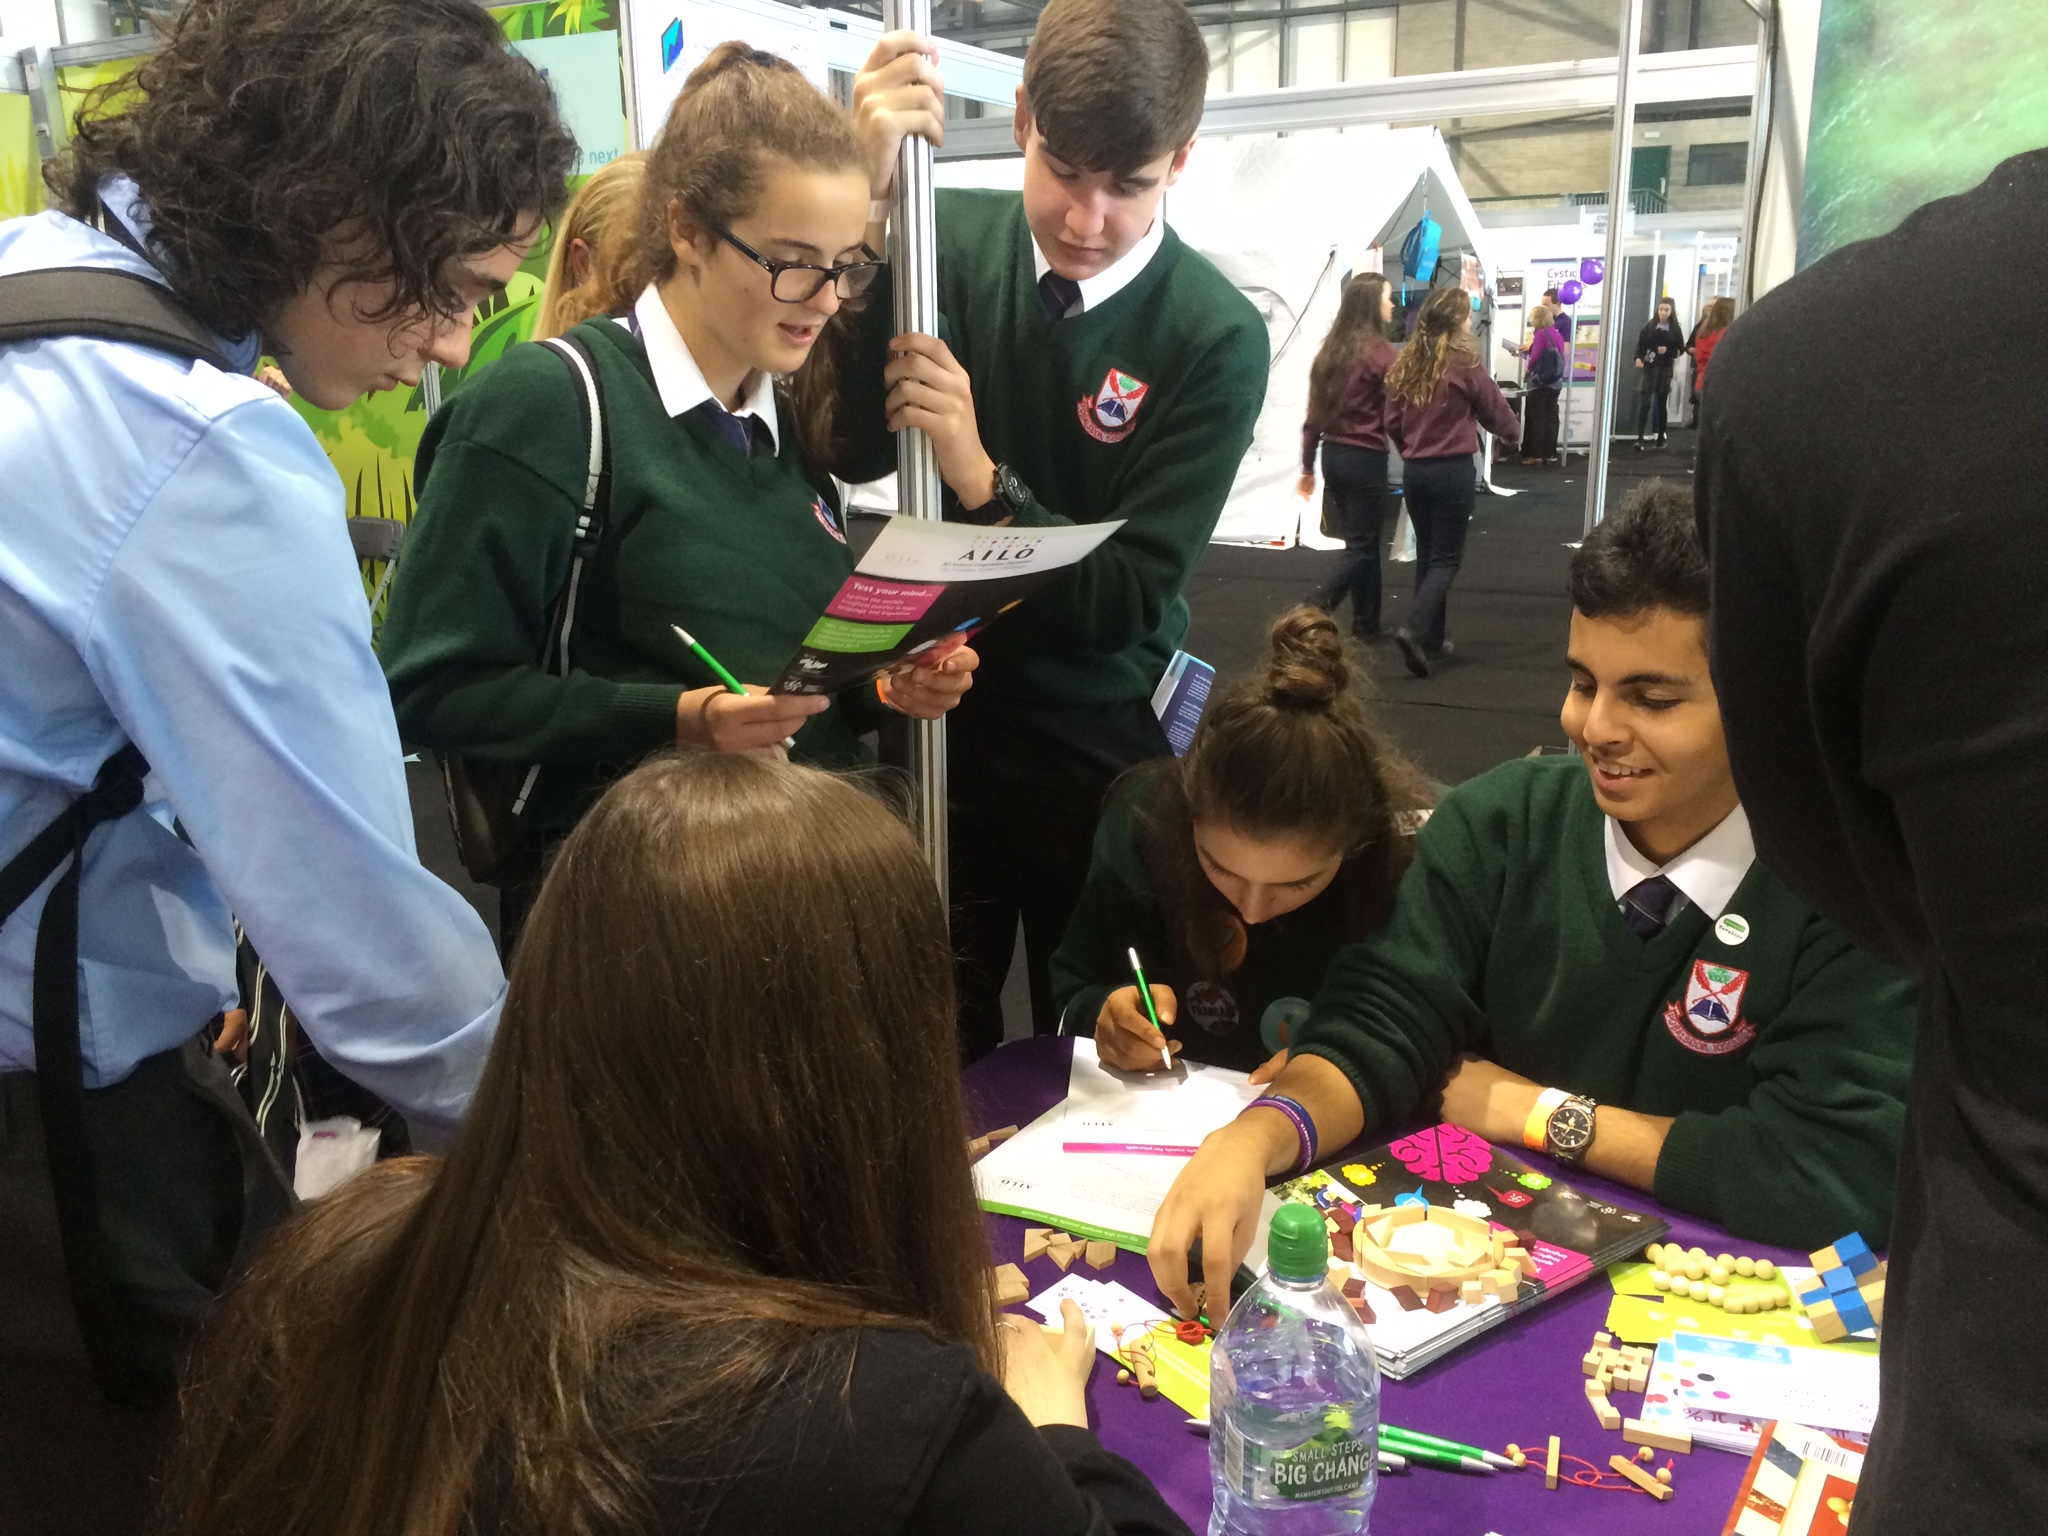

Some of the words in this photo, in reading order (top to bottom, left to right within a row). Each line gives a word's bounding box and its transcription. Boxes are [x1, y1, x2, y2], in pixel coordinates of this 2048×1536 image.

[589, 147, 618, 164] next
[958, 548, 1035, 562] AILO
[853, 581, 874, 593] Test
[875, 588, 900, 598] your
[1291, 1447, 1326, 1463] SMALL
[1331, 1438, 1364, 1457] STEPS
[1274, 1461, 1307, 1486] BIG
